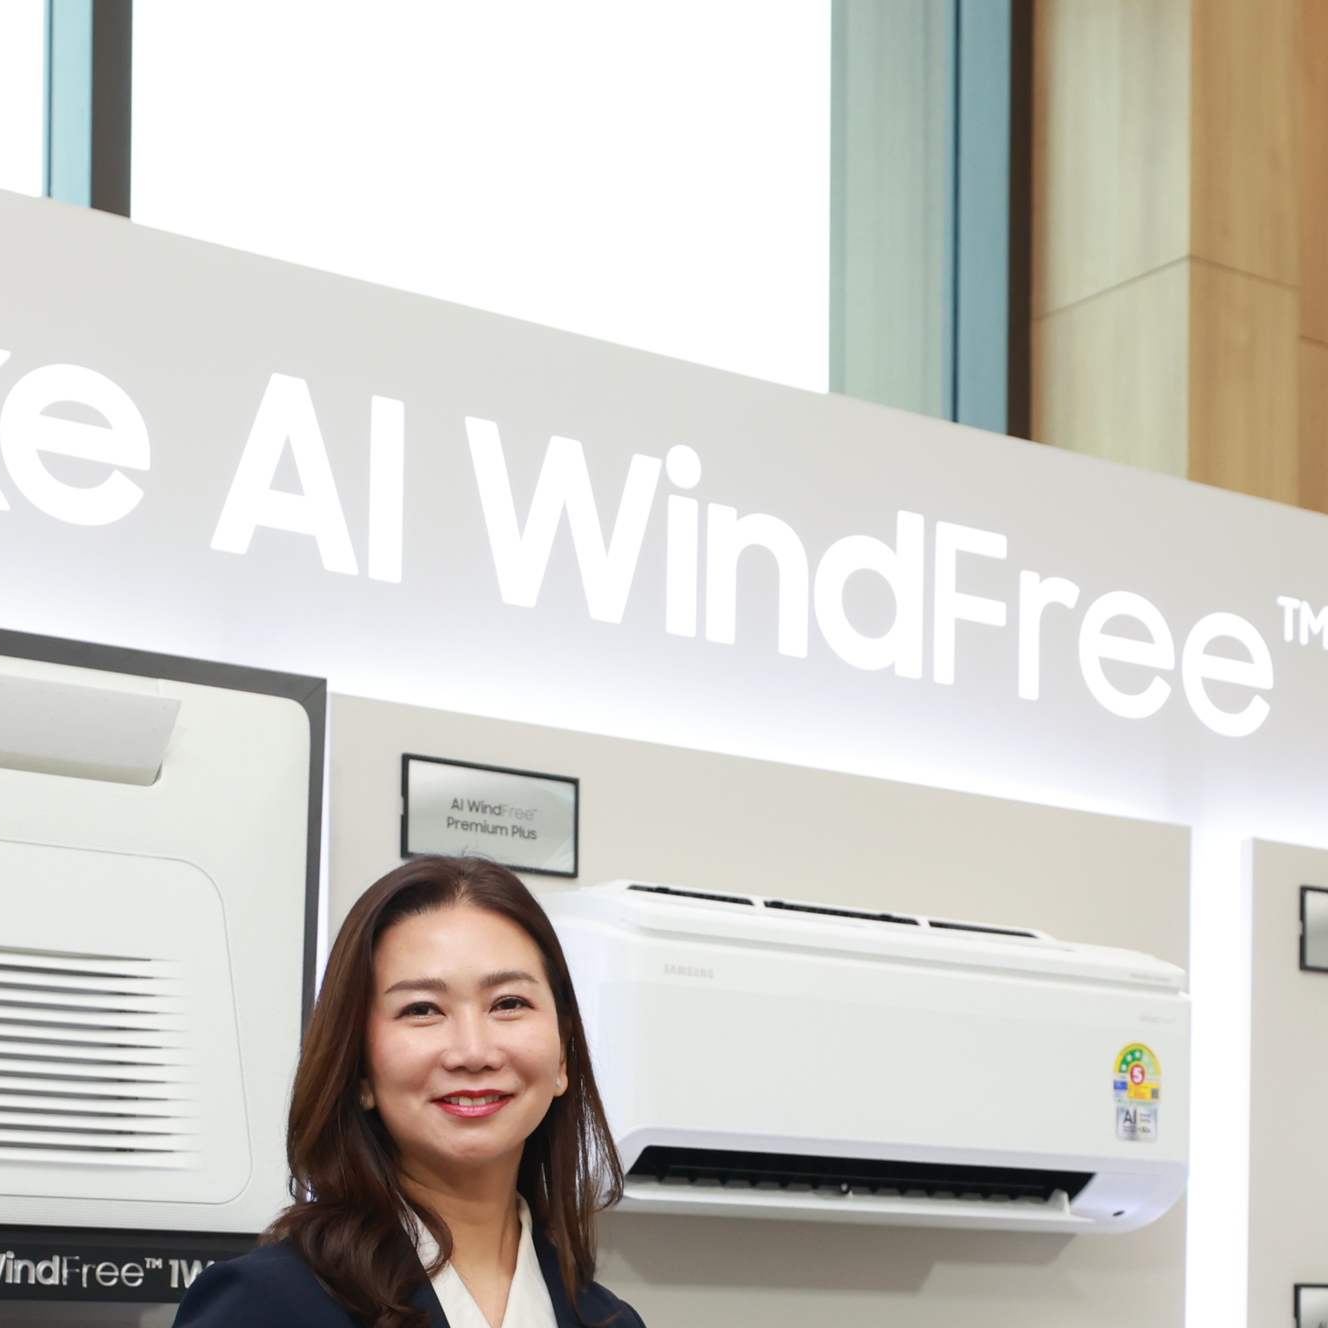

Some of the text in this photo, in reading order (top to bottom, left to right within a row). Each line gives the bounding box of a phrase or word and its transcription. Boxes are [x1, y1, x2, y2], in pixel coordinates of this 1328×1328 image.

[210, 372, 405, 585] AI
[451, 797, 464, 811] AI
[446, 816, 538, 840] Premium Plus
[664, 963, 714, 979] SAMSUNG
[1132, 1066, 1144, 1083] 5
[168, 1258, 216, 1289] 1W
